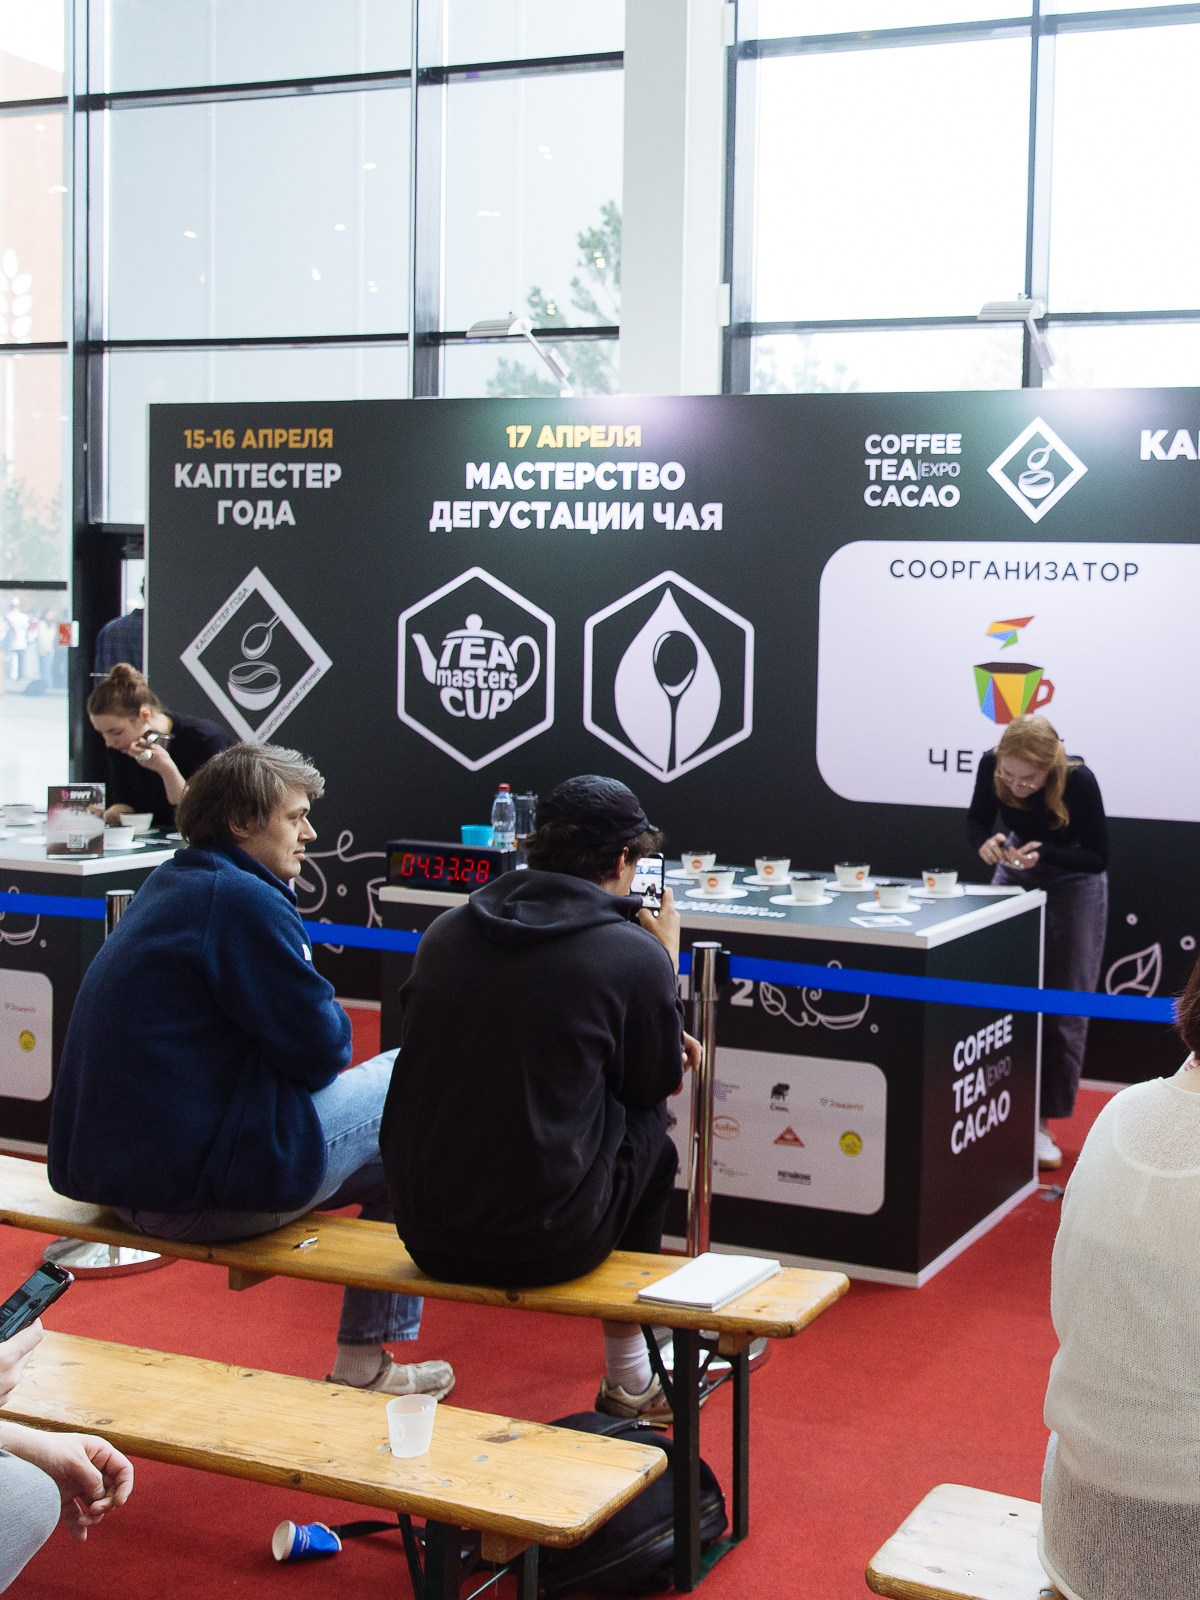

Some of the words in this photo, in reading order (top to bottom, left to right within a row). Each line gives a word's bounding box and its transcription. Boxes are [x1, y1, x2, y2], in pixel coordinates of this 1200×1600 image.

[184, 428, 235, 449] 15-16
[241, 428, 334, 449] АПРЕЛЯ
[506, 426, 532, 448] 17
[536, 425, 642, 447] АПРЕЛЯ
[864, 433, 962, 456] COFFEE
[174, 462, 342, 489] КАПТЕСТЕР
[465, 461, 686, 491] МАСТЕРСТВО
[865, 458, 917, 481] TEA
[863, 485, 961, 508] CACAO
[217, 501, 296, 530] ГОДА
[428, 500, 644, 534] ДЕГУСТАЦИИ
[653, 502, 723, 531] ЧАЯ
[890, 558, 1140, 583] СООРГАНИЗАТОР
[439, 637, 515, 671] TEA
[436, 667, 518, 690] masters
[440, 686, 514, 720] CUP
[953, 1013, 1013, 1072] COFFEE
[952, 1067, 987, 1114] TEA
[951, 1090, 1011, 1155] CACAO
